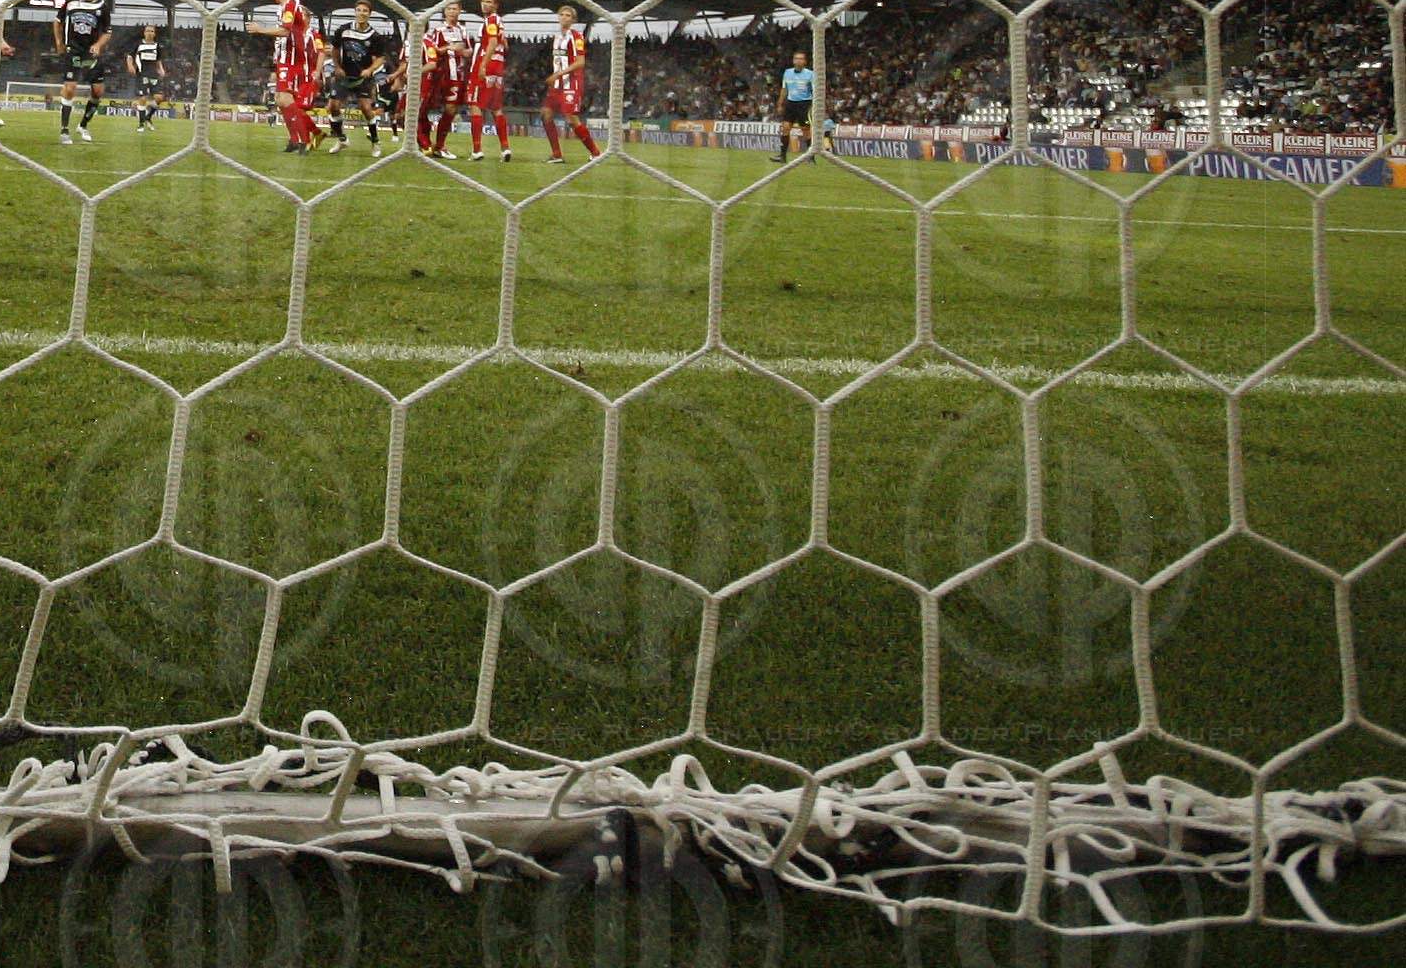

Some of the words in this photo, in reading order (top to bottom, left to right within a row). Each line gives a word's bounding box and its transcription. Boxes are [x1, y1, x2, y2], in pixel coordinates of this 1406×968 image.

[1102, 132, 1132, 142] KLEINE
[1142, 132, 1174, 142] KLEINE
[1186, 133, 1210, 143] KLEI
[1233, 134, 1272, 146] KLEINE
[1284, 135, 1324, 147] KLEINE
[1330, 136, 1375, 148] KLEINE
[834, 139, 909, 160] UNTIGAMER
[975, 143, 1090, 170] PUIGAMER
